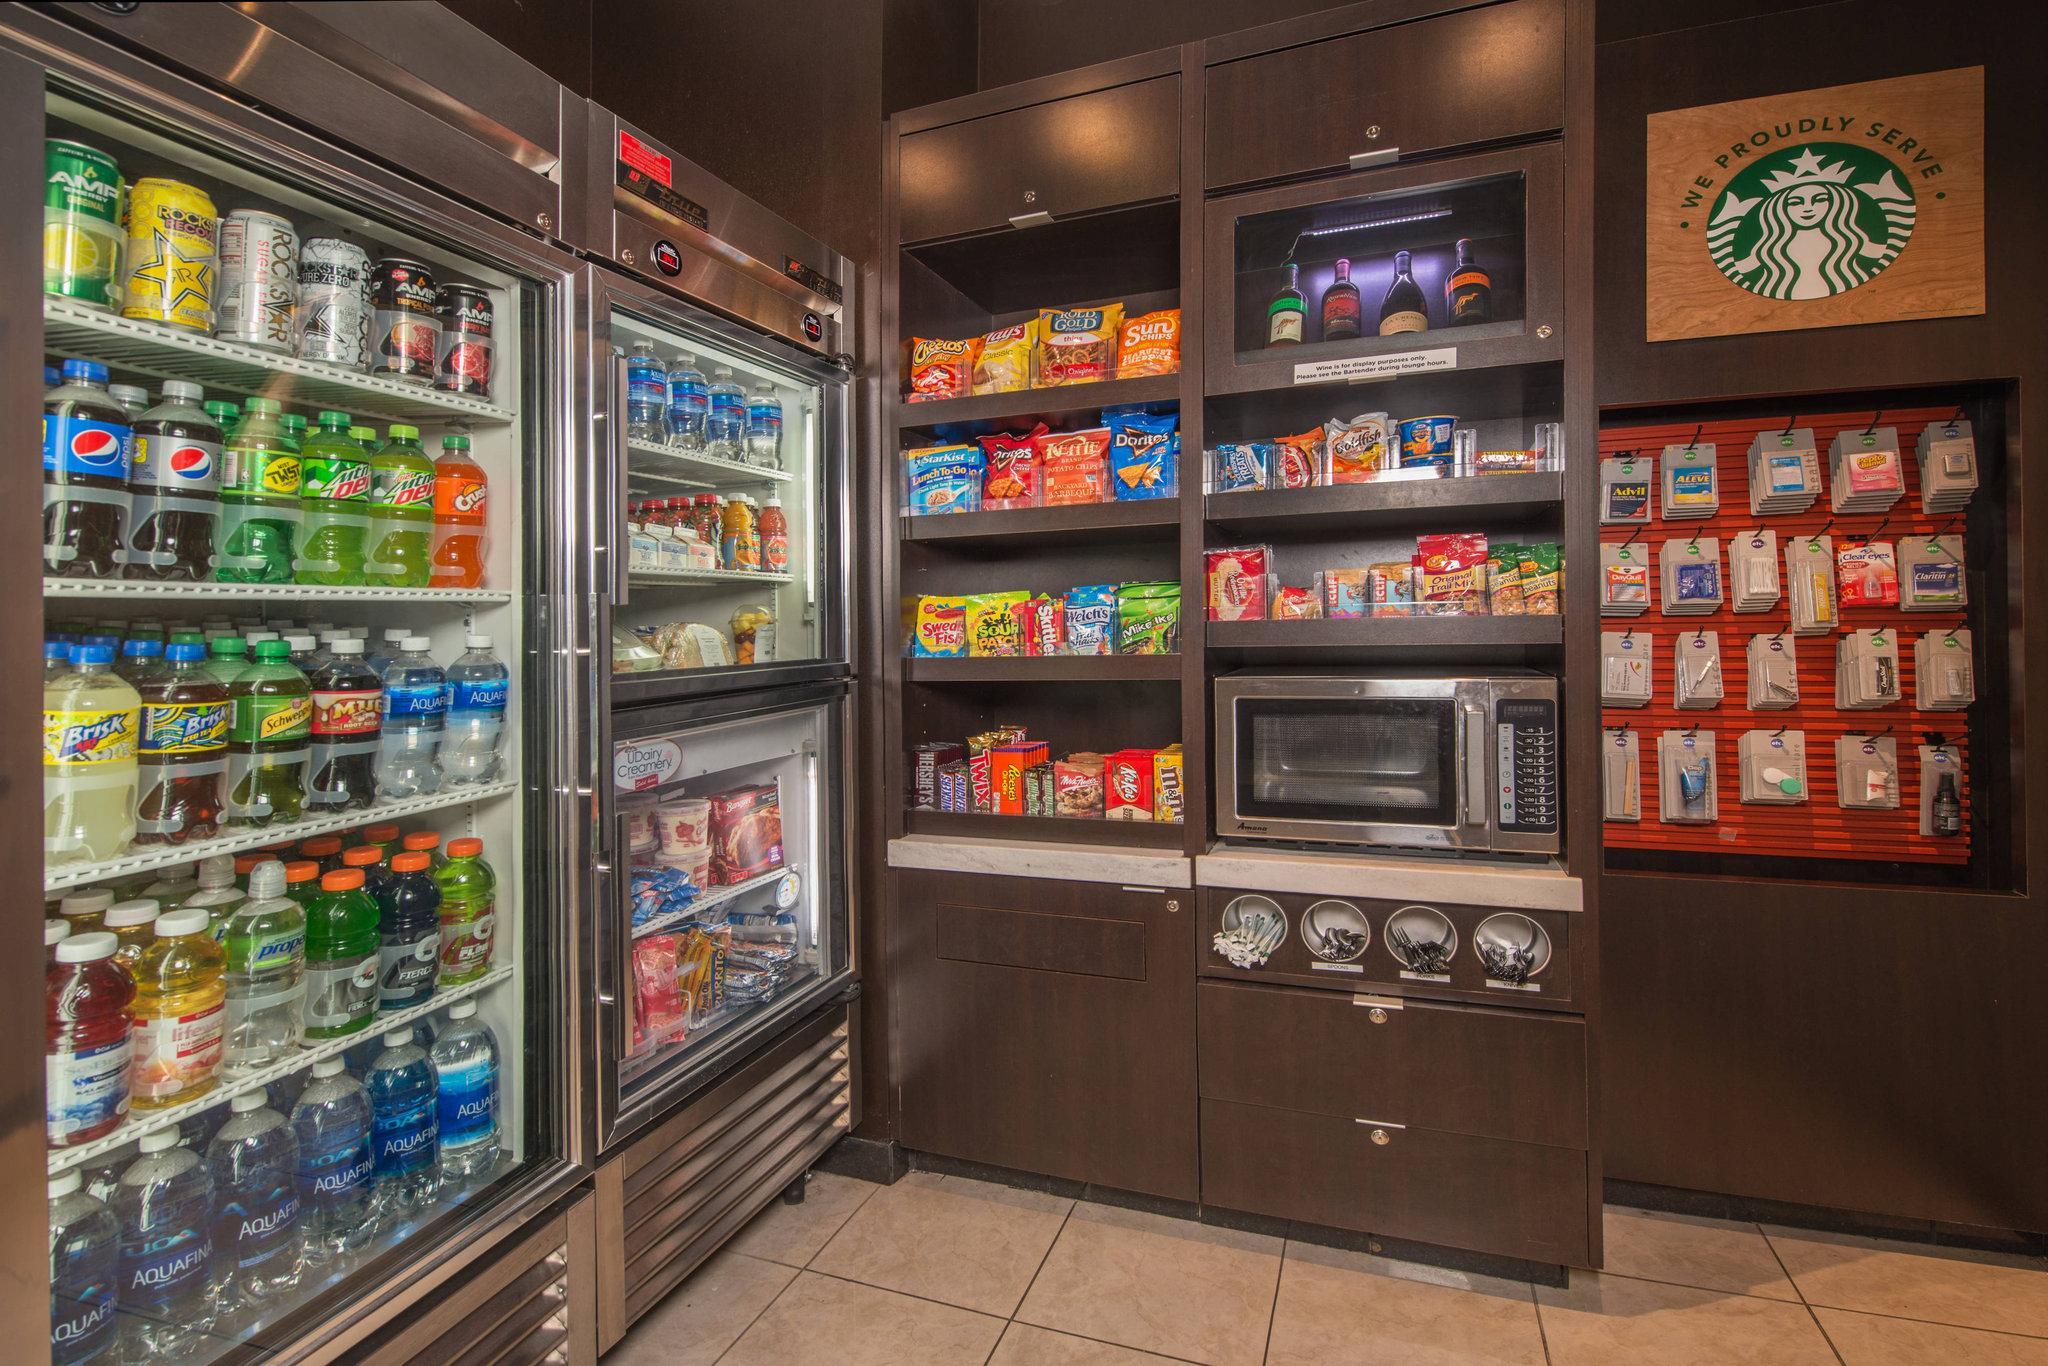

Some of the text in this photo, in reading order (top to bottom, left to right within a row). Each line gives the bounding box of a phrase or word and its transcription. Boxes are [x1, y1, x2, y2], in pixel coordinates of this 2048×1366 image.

[1681, 116, 1943, 210] WE PROUDLY SERVE
[321, 273, 350, 287] ZERO
[1055, 317, 1097, 331] GOLD
[1125, 321, 1173, 347] Sun
[1140, 333, 1172, 341] CHIPS
[913, 339, 967, 366] Cheetos
[983, 349, 1014, 361] Classic
[1377, 356, 1408, 366] purposes
[1410, 355, 1427, 363] only.
[1343, 366, 1377, 375] Bartender
[1378, 364, 1400, 372] during
[1401, 362, 1426, 370] lounge
[1115, 432, 1170, 447] Doritos
[1335, 429, 1382, 455] Goldfish
[121, 436, 131, 469] pepsi
[922, 452, 966, 464] StarKist
[1047, 462, 1098, 473] POTATO CHIPS
[912, 465, 967, 486] Lunch To-Go
[1675, 475, 1711, 484] ALEVE
[1612, 487, 1646, 496] Advil
[1843, 553, 1890, 562] Clear eyes
[1432, 571, 1473, 585] Original
[1611, 574, 1642, 582] DayQuil
[1915, 573, 1946, 581] Claritin
[1429, 579, 1476, 594] Trail Mix
[1065, 608, 1110, 623] Welch's
[1123, 621, 1153, 639] Mike
[617, 758, 673, 778] Creamery
[919, 750, 934, 804] HERSHEY'S
[970, 749, 992, 807] TWIX
[1237, 822, 1268, 832] Amana
[132, 1238, 213, 1289] AQUAFINA
